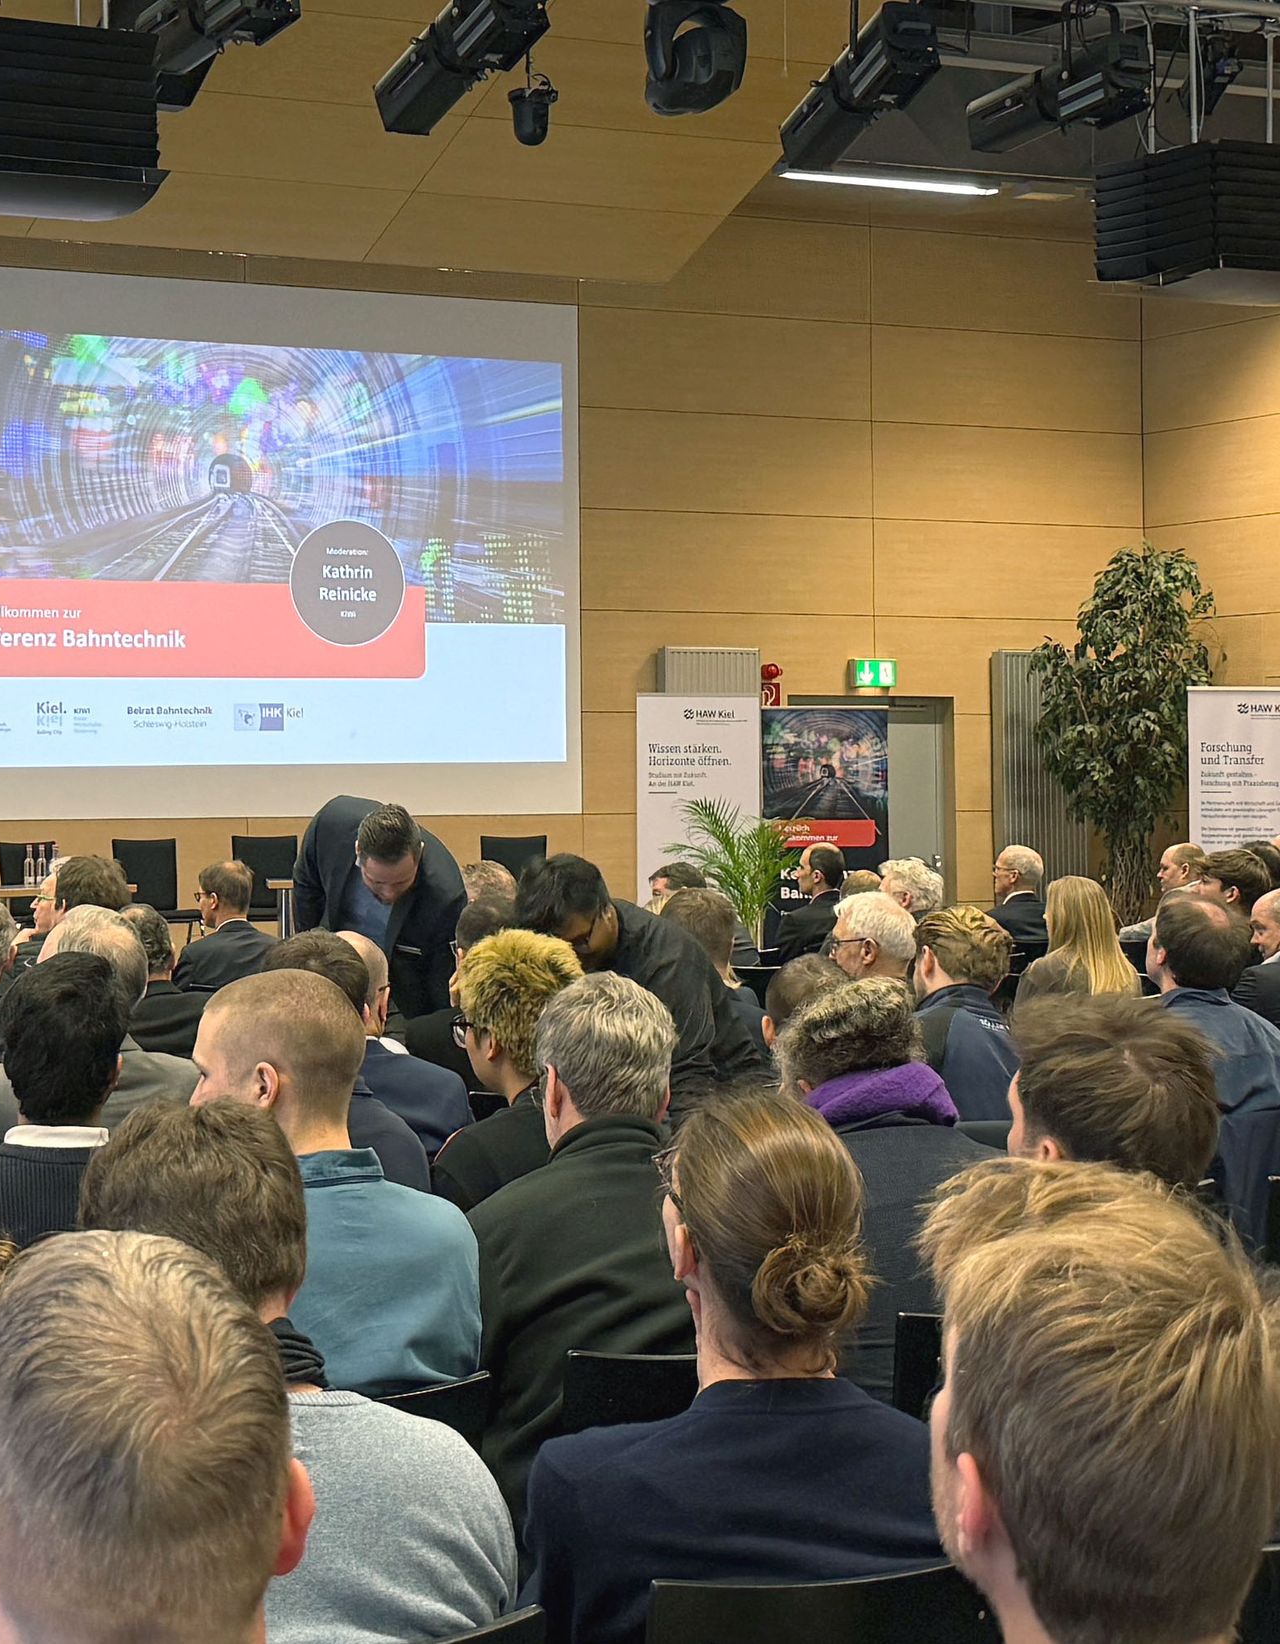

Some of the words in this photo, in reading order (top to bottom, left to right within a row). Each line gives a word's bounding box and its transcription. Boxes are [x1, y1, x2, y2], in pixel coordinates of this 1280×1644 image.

[326, 547, 368, 556] Moderation:
[323, 565, 372, 578] Kathrin
[320, 587, 376, 601] Reinicke
[63, 609, 82, 619] zur
[63, 629, 186, 648] Bahntechnik
[37, 701, 66, 714] Kiel.
[127, 707, 154, 715] Beirat
[157, 707, 212, 716] Bahntechnik
[1250, 705, 1273, 713] HAW
[262, 708, 282, 718] IHK
[287, 708, 304, 718] Kiel
[696, 710, 716, 718] HAW
[718, 710, 734, 718] Kiel
[133, 720, 206, 730] Schleswig-Holstein
[649, 744, 681, 754] Wissen
[684, 743, 722, 754] stärken.
[1201, 742, 1252, 754] Forschung
[649, 756, 696, 766] Horizonte
[698, 756, 732, 766] öffnen.
[1201, 755, 1220, 764] und
[1223, 755, 1264, 765] Transfer
[779, 825, 810, 833] erzlich
